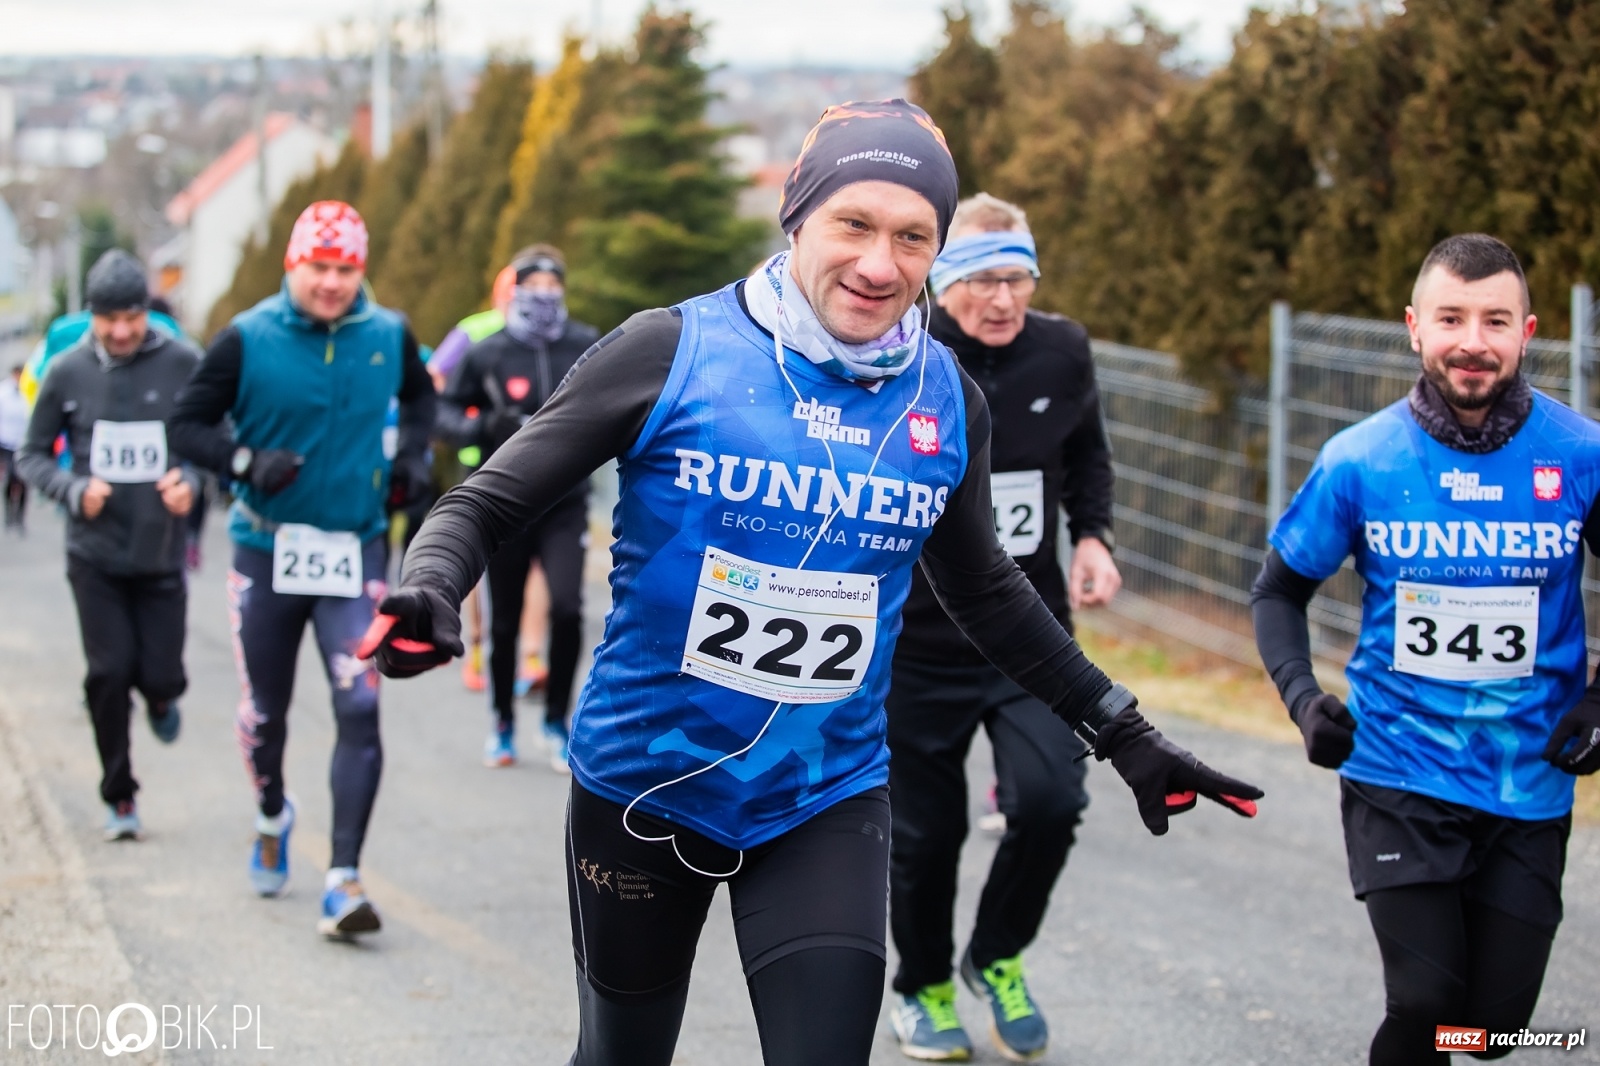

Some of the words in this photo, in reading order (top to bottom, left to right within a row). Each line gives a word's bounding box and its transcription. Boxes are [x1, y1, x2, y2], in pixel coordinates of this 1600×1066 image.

[836, 149, 919, 166] runspiration
[98, 444, 159, 468] 389
[673, 448, 949, 528] RUNNERS
[858, 532, 914, 552] TEAM
[1365, 519, 1584, 559] RUNNERS
[282, 552, 353, 579] 254
[1500, 565, 1549, 580] TEAM
[768, 582, 872, 603] www.personalbest.pl
[697, 602, 863, 681] 222
[1405, 616, 1528, 663] 343
[617, 881, 650, 891] Running
[618, 891, 639, 900] Team
